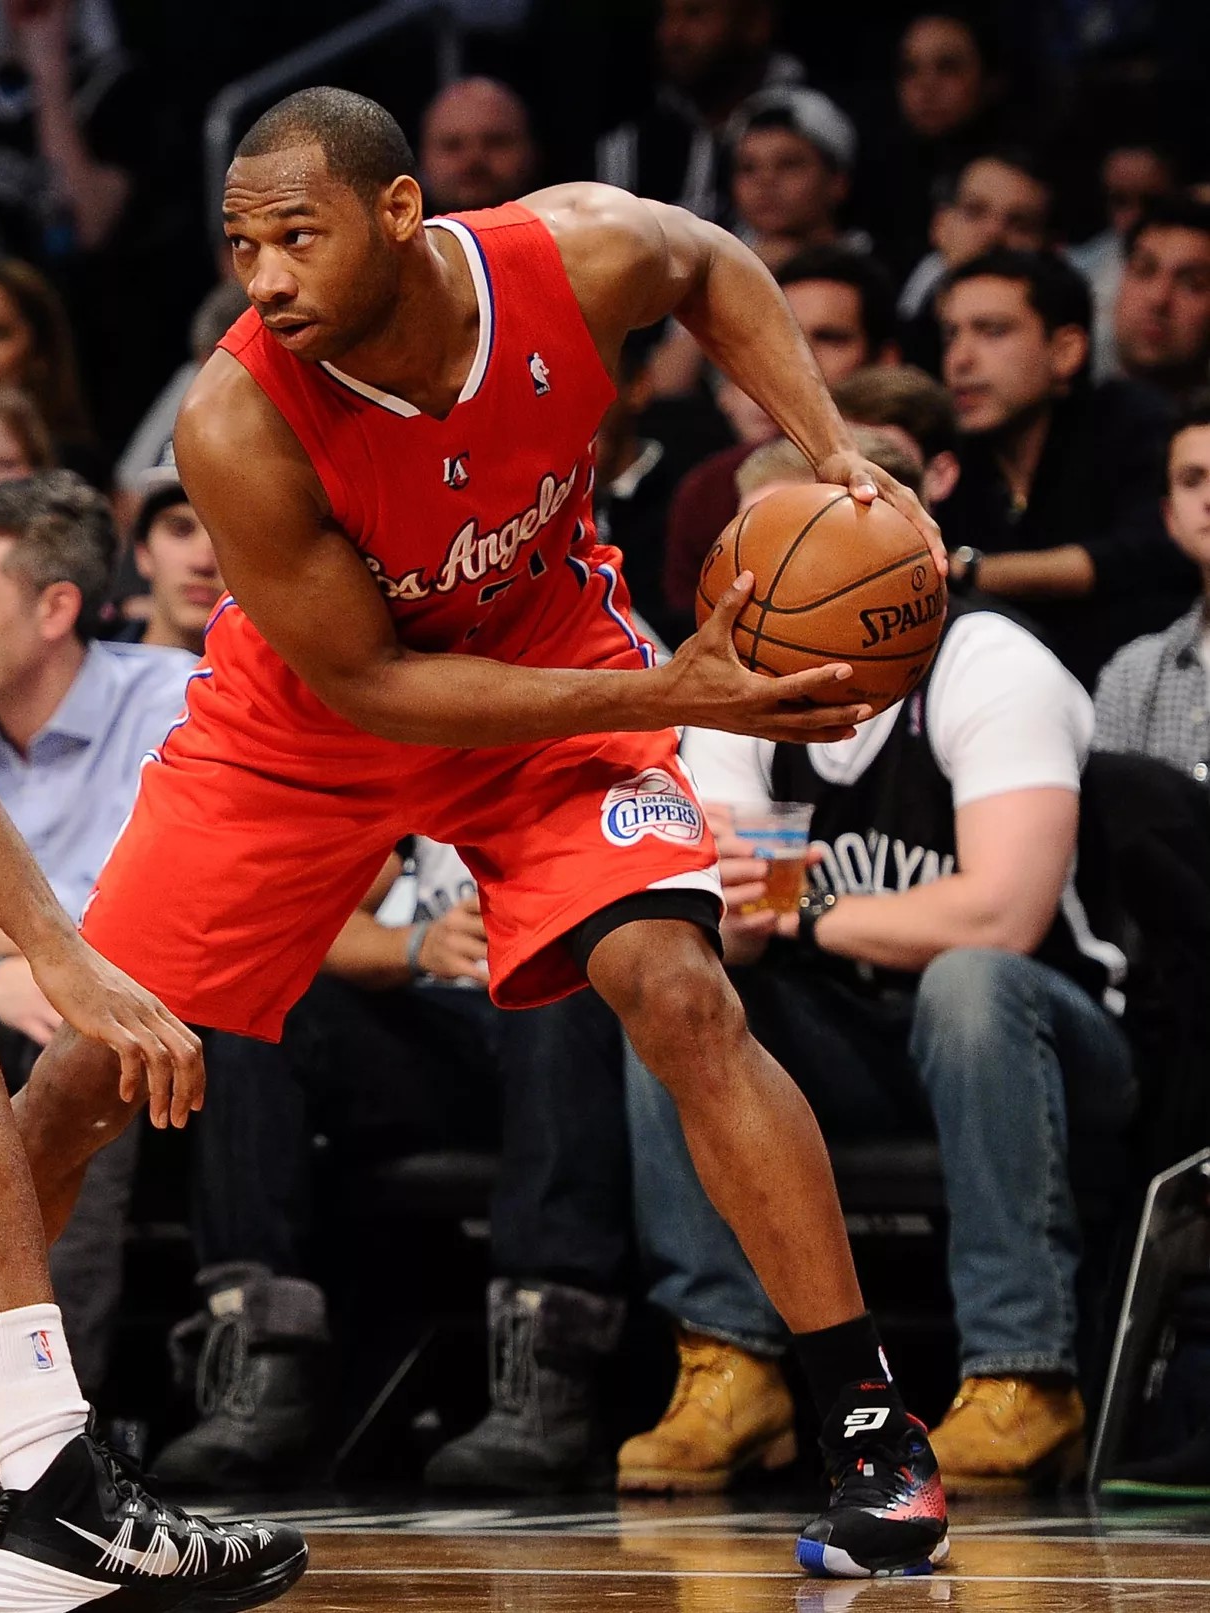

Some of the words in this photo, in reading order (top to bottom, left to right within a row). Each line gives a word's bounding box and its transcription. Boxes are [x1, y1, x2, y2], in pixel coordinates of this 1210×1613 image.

[364, 556, 430, 601] os
[607, 797, 697, 840] CLIPPERS
[641, 796, 657, 804] LOS
